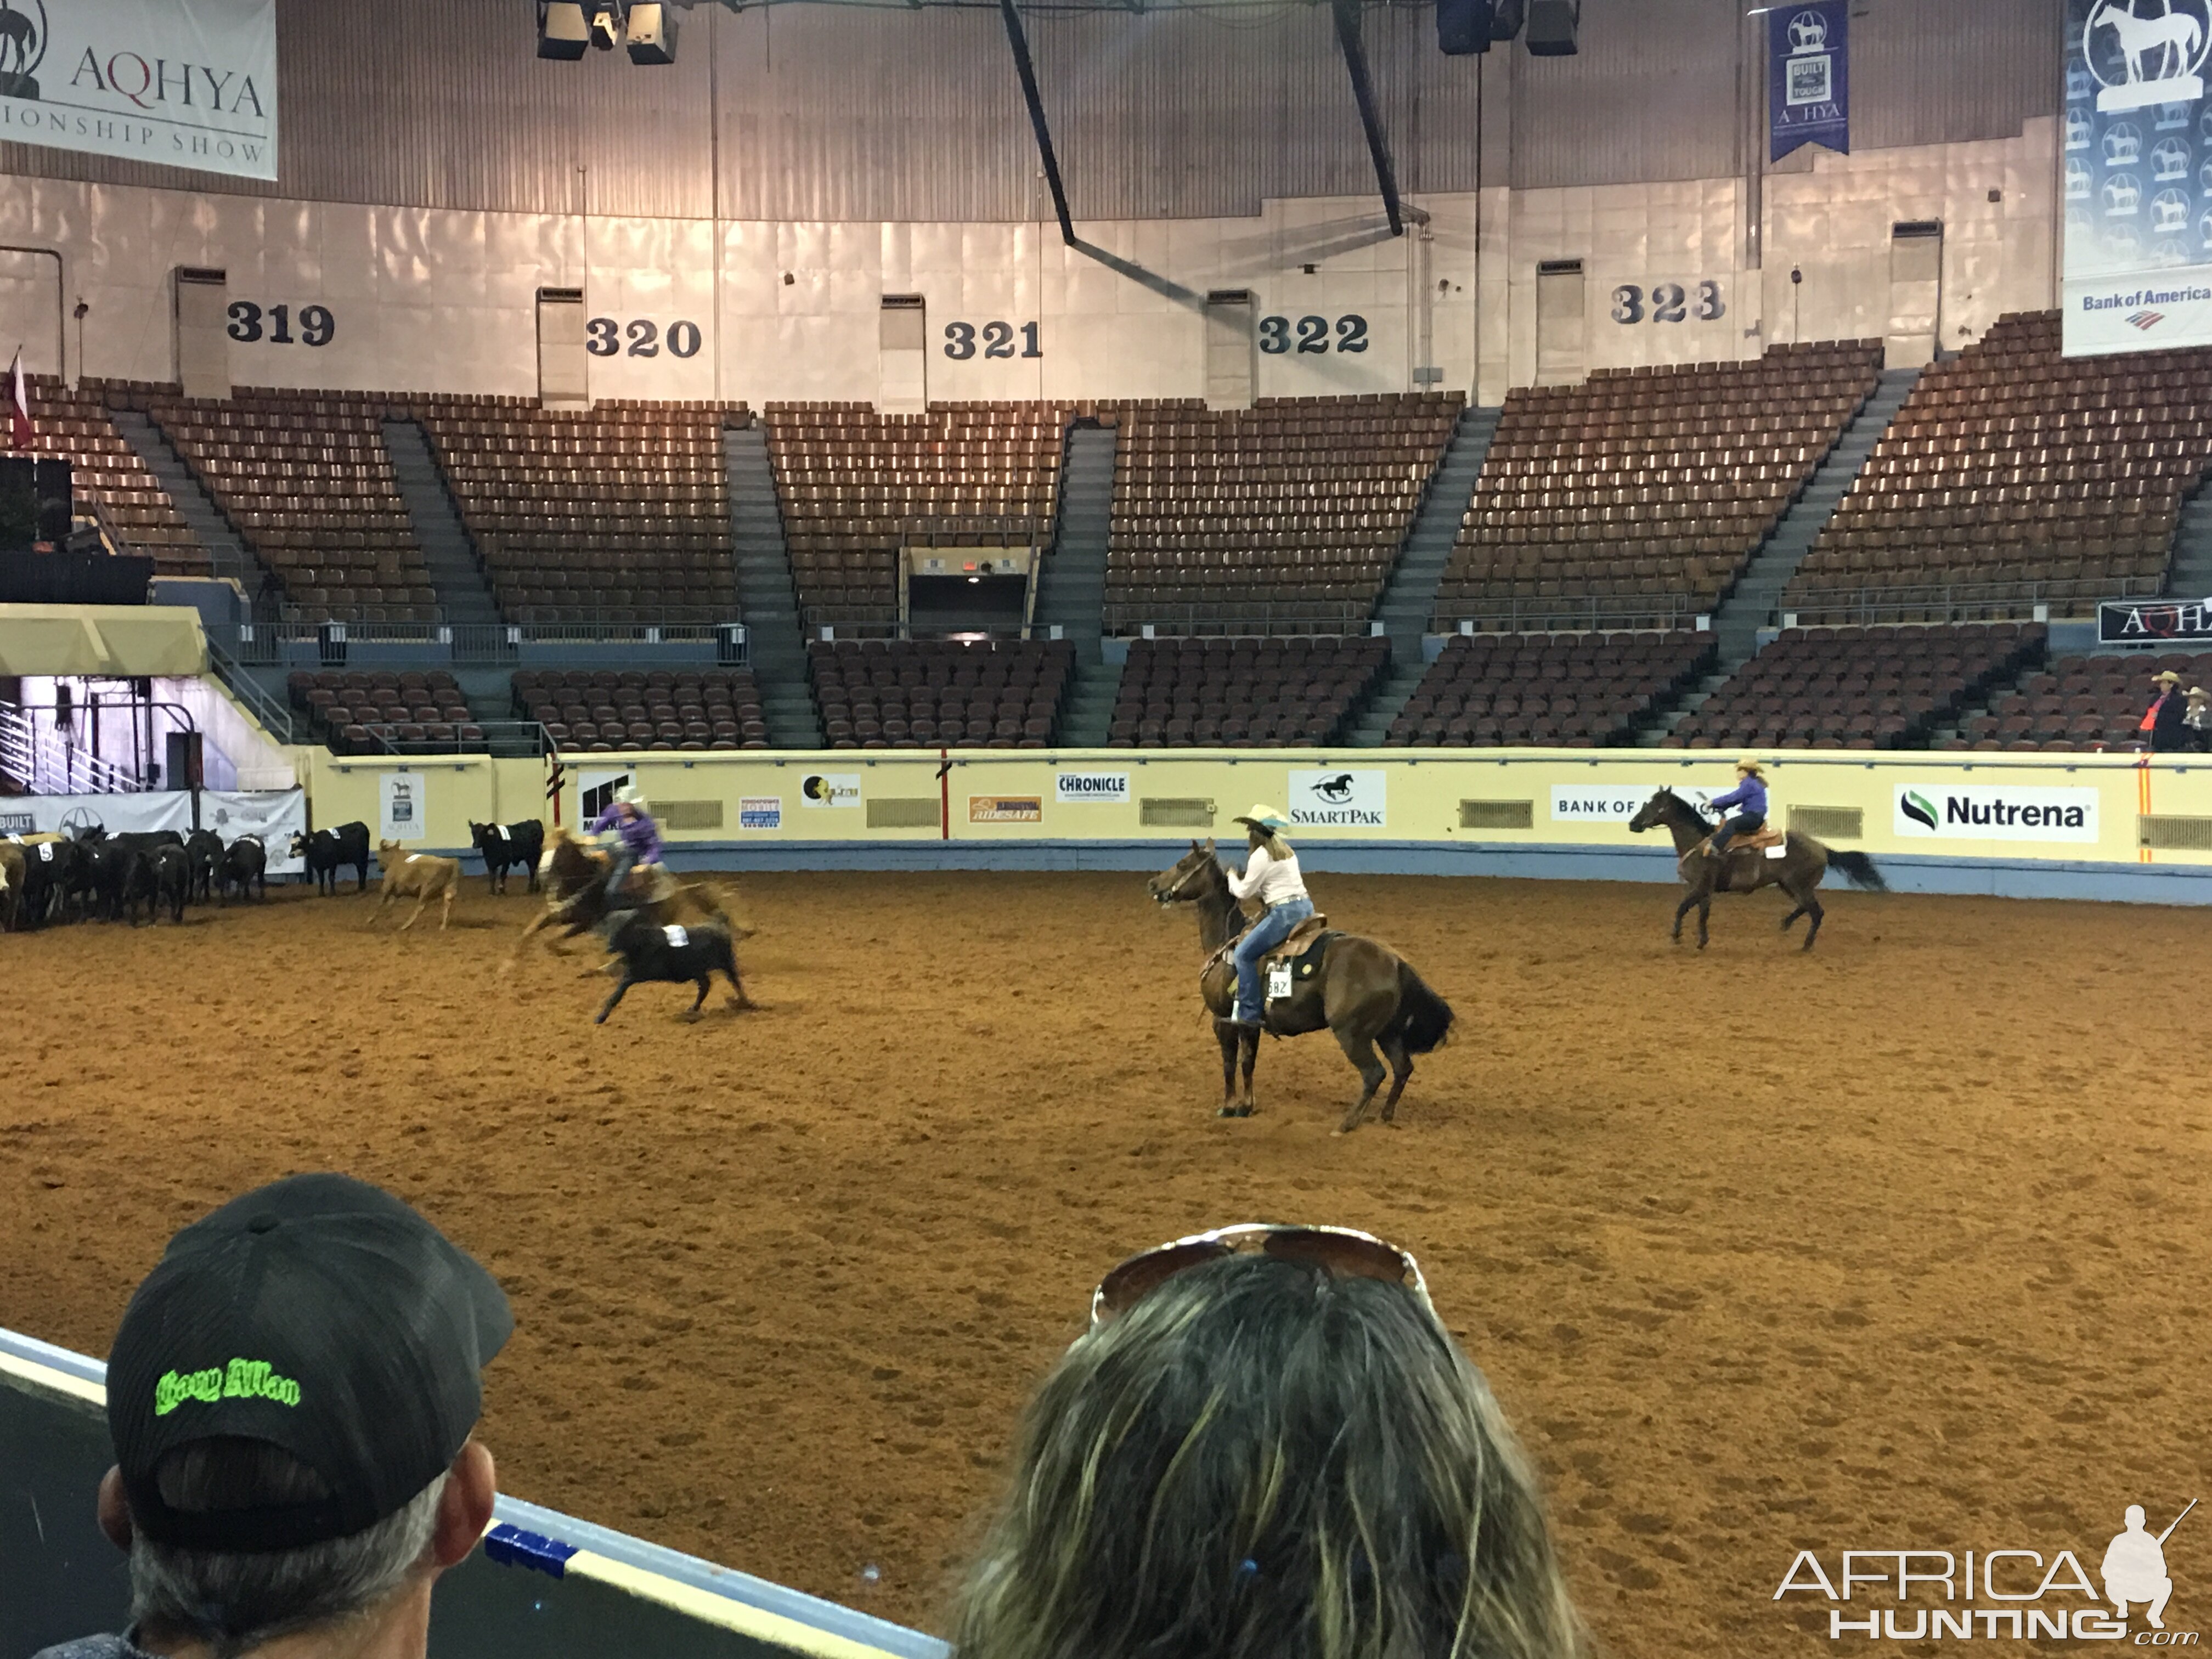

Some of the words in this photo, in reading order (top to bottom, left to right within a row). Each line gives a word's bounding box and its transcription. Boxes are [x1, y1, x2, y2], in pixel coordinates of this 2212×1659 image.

[71, 46, 267, 117] AQHYA
[1793, 63, 1824, 76] BUILT
[1794, 84, 1825, 97] TOUGH
[4, 105, 153, 145] IONSHIP
[173, 133, 263, 162] SHOW
[1611, 280, 1726, 324] 323
[2083, 294, 2123, 311] Bank
[2125, 291, 2142, 307] of
[2144, 286, 2211, 305] America
[227, 301, 335, 347] 319
[586, 318, 702, 358] 320
[1259, 314, 1368, 354] 322
[944, 321, 1043, 360] 321
[2120, 604, 2212, 637] AQH
[1059, 777, 1125, 792] CHRONICLE
[0, 815, 31, 829] BUILT
[972, 810, 1039, 820] RIDESAFE
[1559, 799, 1607, 813] BANK
[1613, 800, 1635, 813] OF
[1947, 796, 2084, 828] Nutrena
[42, 848, 52, 860] 5
[223, 1357, 301, 1407] Allan
